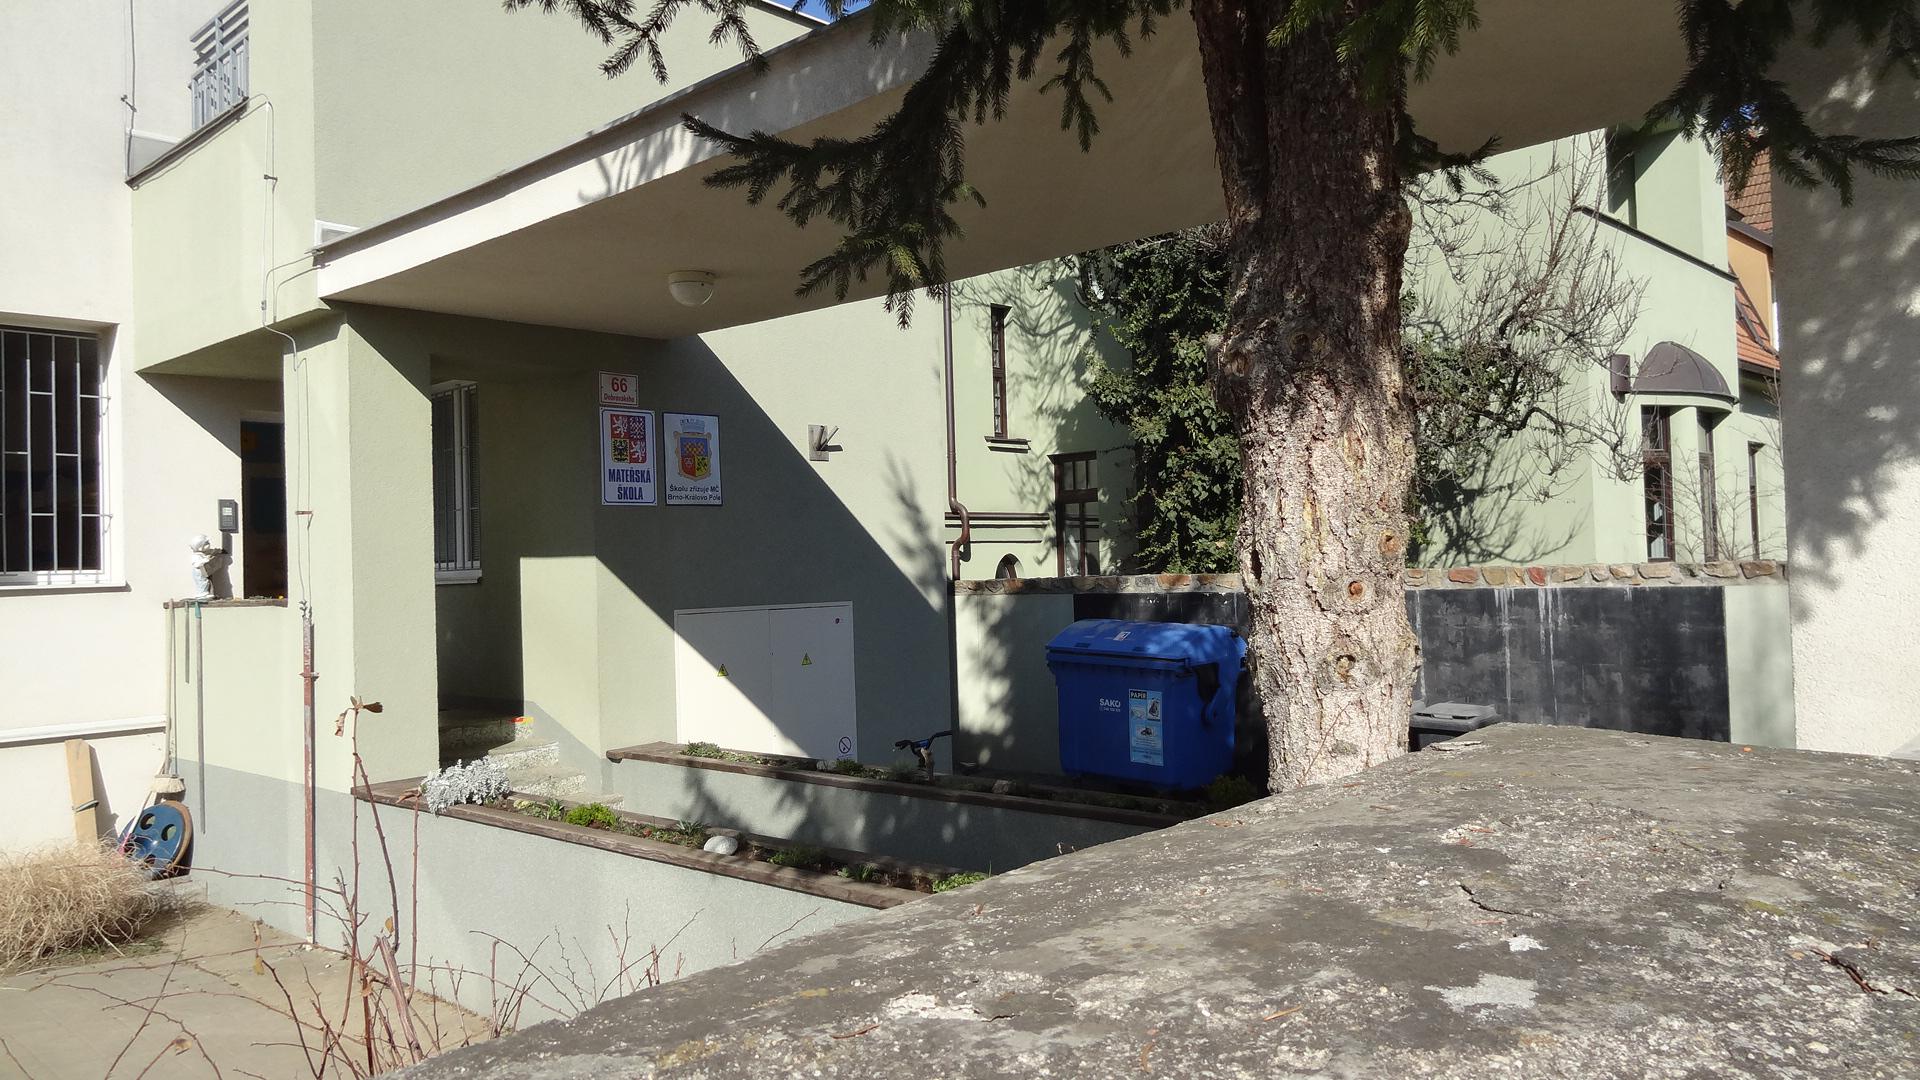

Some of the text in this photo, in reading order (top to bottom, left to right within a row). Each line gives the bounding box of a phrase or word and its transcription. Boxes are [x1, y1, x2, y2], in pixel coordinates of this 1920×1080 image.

[611, 377, 628, 392] 66
[608, 467, 651, 483] MATEŘSKÁ
[617, 484, 644, 500] ŠKOLA
[669, 484, 688, 492] Školu
[689, 485, 709, 493] zřizuje
[1099, 698, 1121, 708] SAKO
